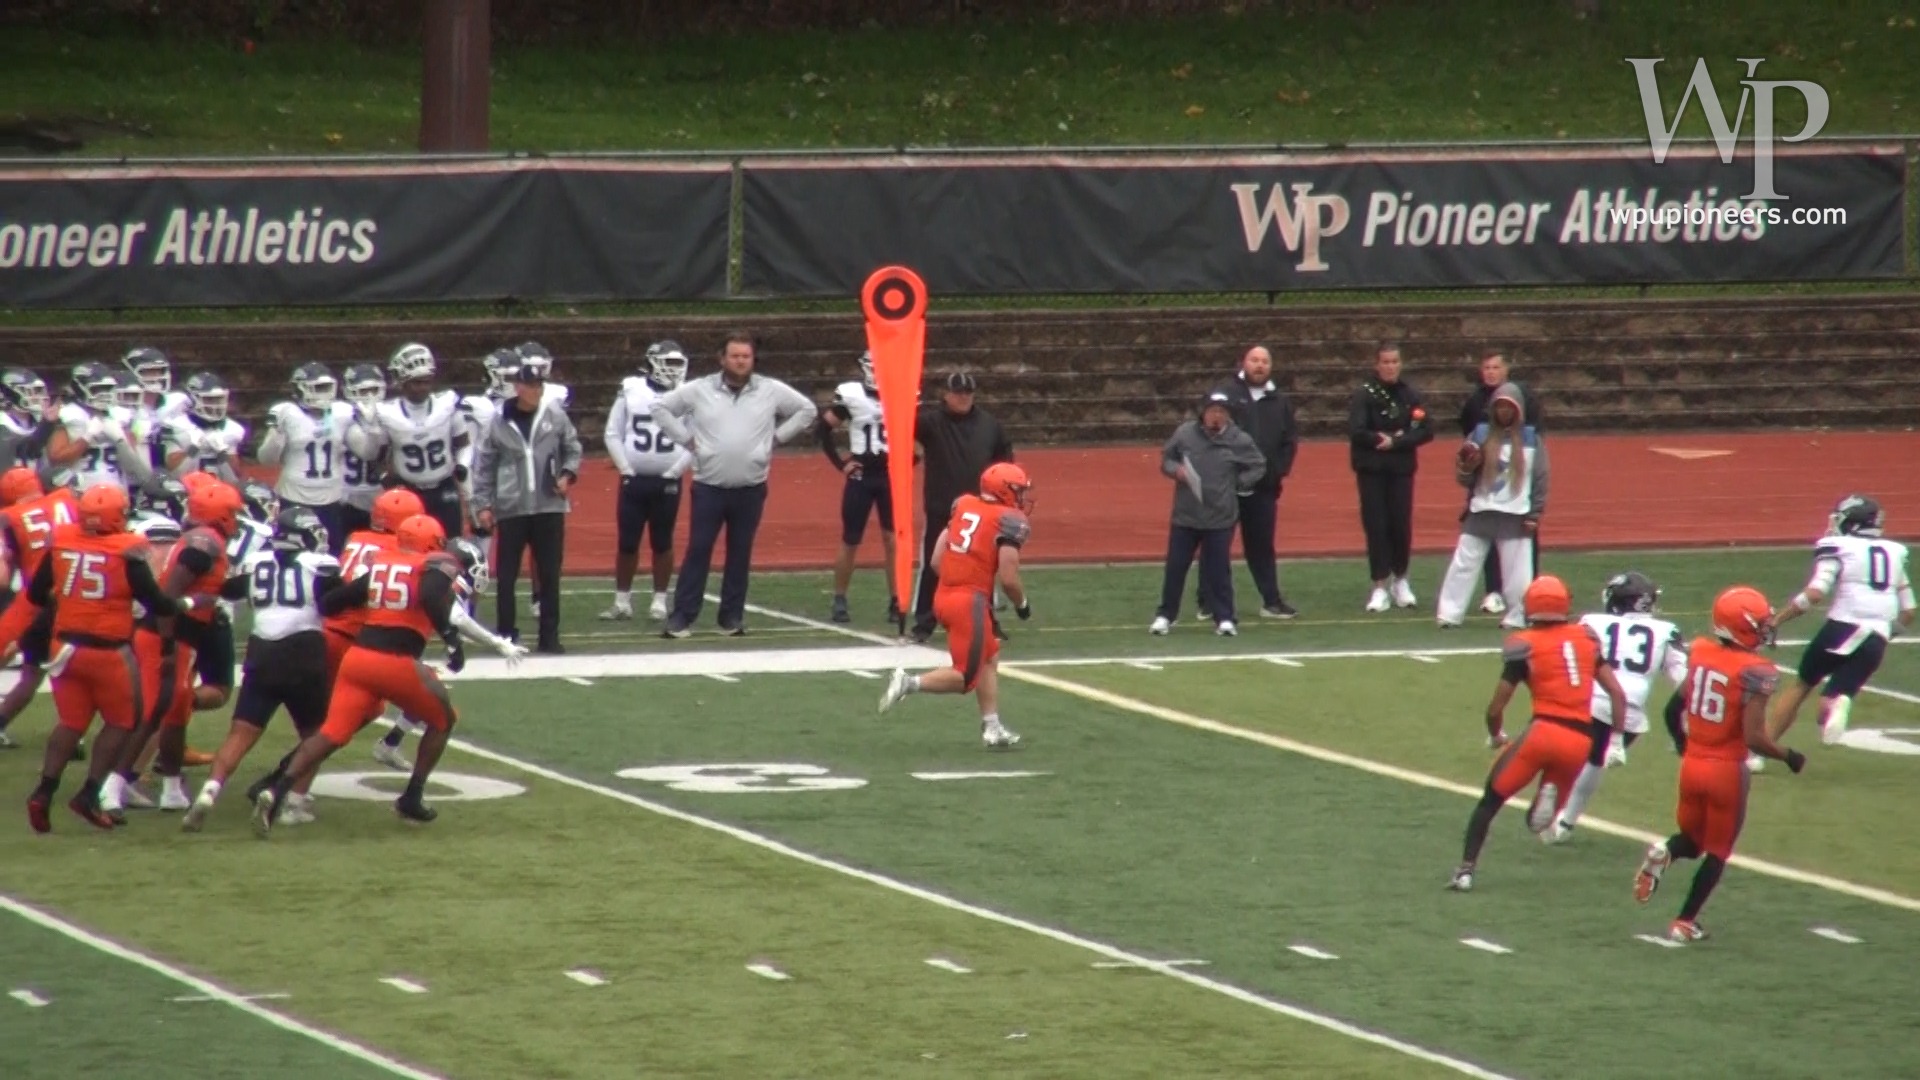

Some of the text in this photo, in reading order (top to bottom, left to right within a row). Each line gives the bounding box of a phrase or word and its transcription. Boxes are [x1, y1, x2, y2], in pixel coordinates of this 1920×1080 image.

[0, 206, 378, 268] oneer Athletics
[1230, 182, 1769, 272] WP Pioneer Athletics
[305, 440, 333, 479] 11
[401, 439, 446, 473] 92
[949, 512, 981, 554] 3
[61, 552, 107, 600] 75
[254, 560, 305, 609] 90
[366, 564, 412, 611] 55
[1868, 546, 1890, 591] 0
[1562, 640, 1580, 687] 1
[1603, 622, 1655, 674] 13
[1690, 666, 1729, 724] 16
